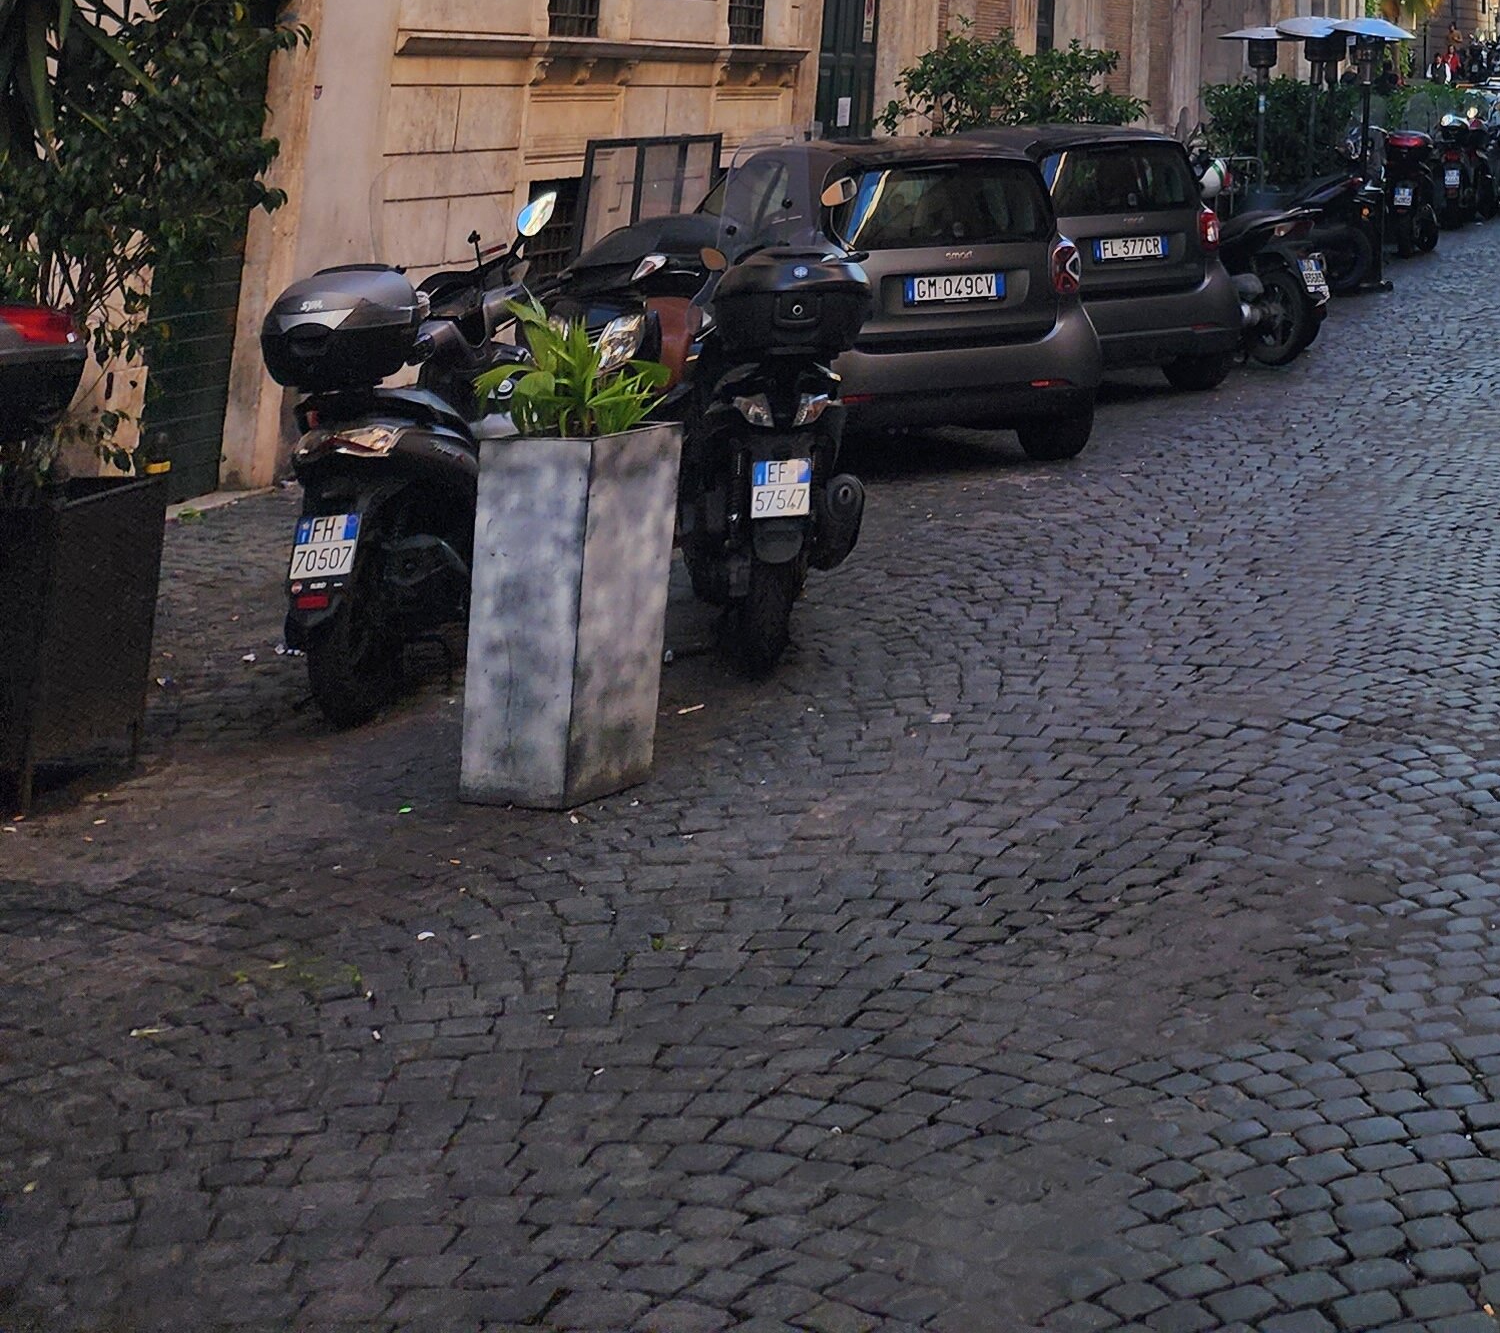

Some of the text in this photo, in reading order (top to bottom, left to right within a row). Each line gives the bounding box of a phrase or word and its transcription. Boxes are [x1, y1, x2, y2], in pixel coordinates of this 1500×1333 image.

[768, 462, 788, 483] EF
[755, 488, 806, 511] 57547
[311, 517, 336, 542] FH
[293, 546, 352, 574] 70507
